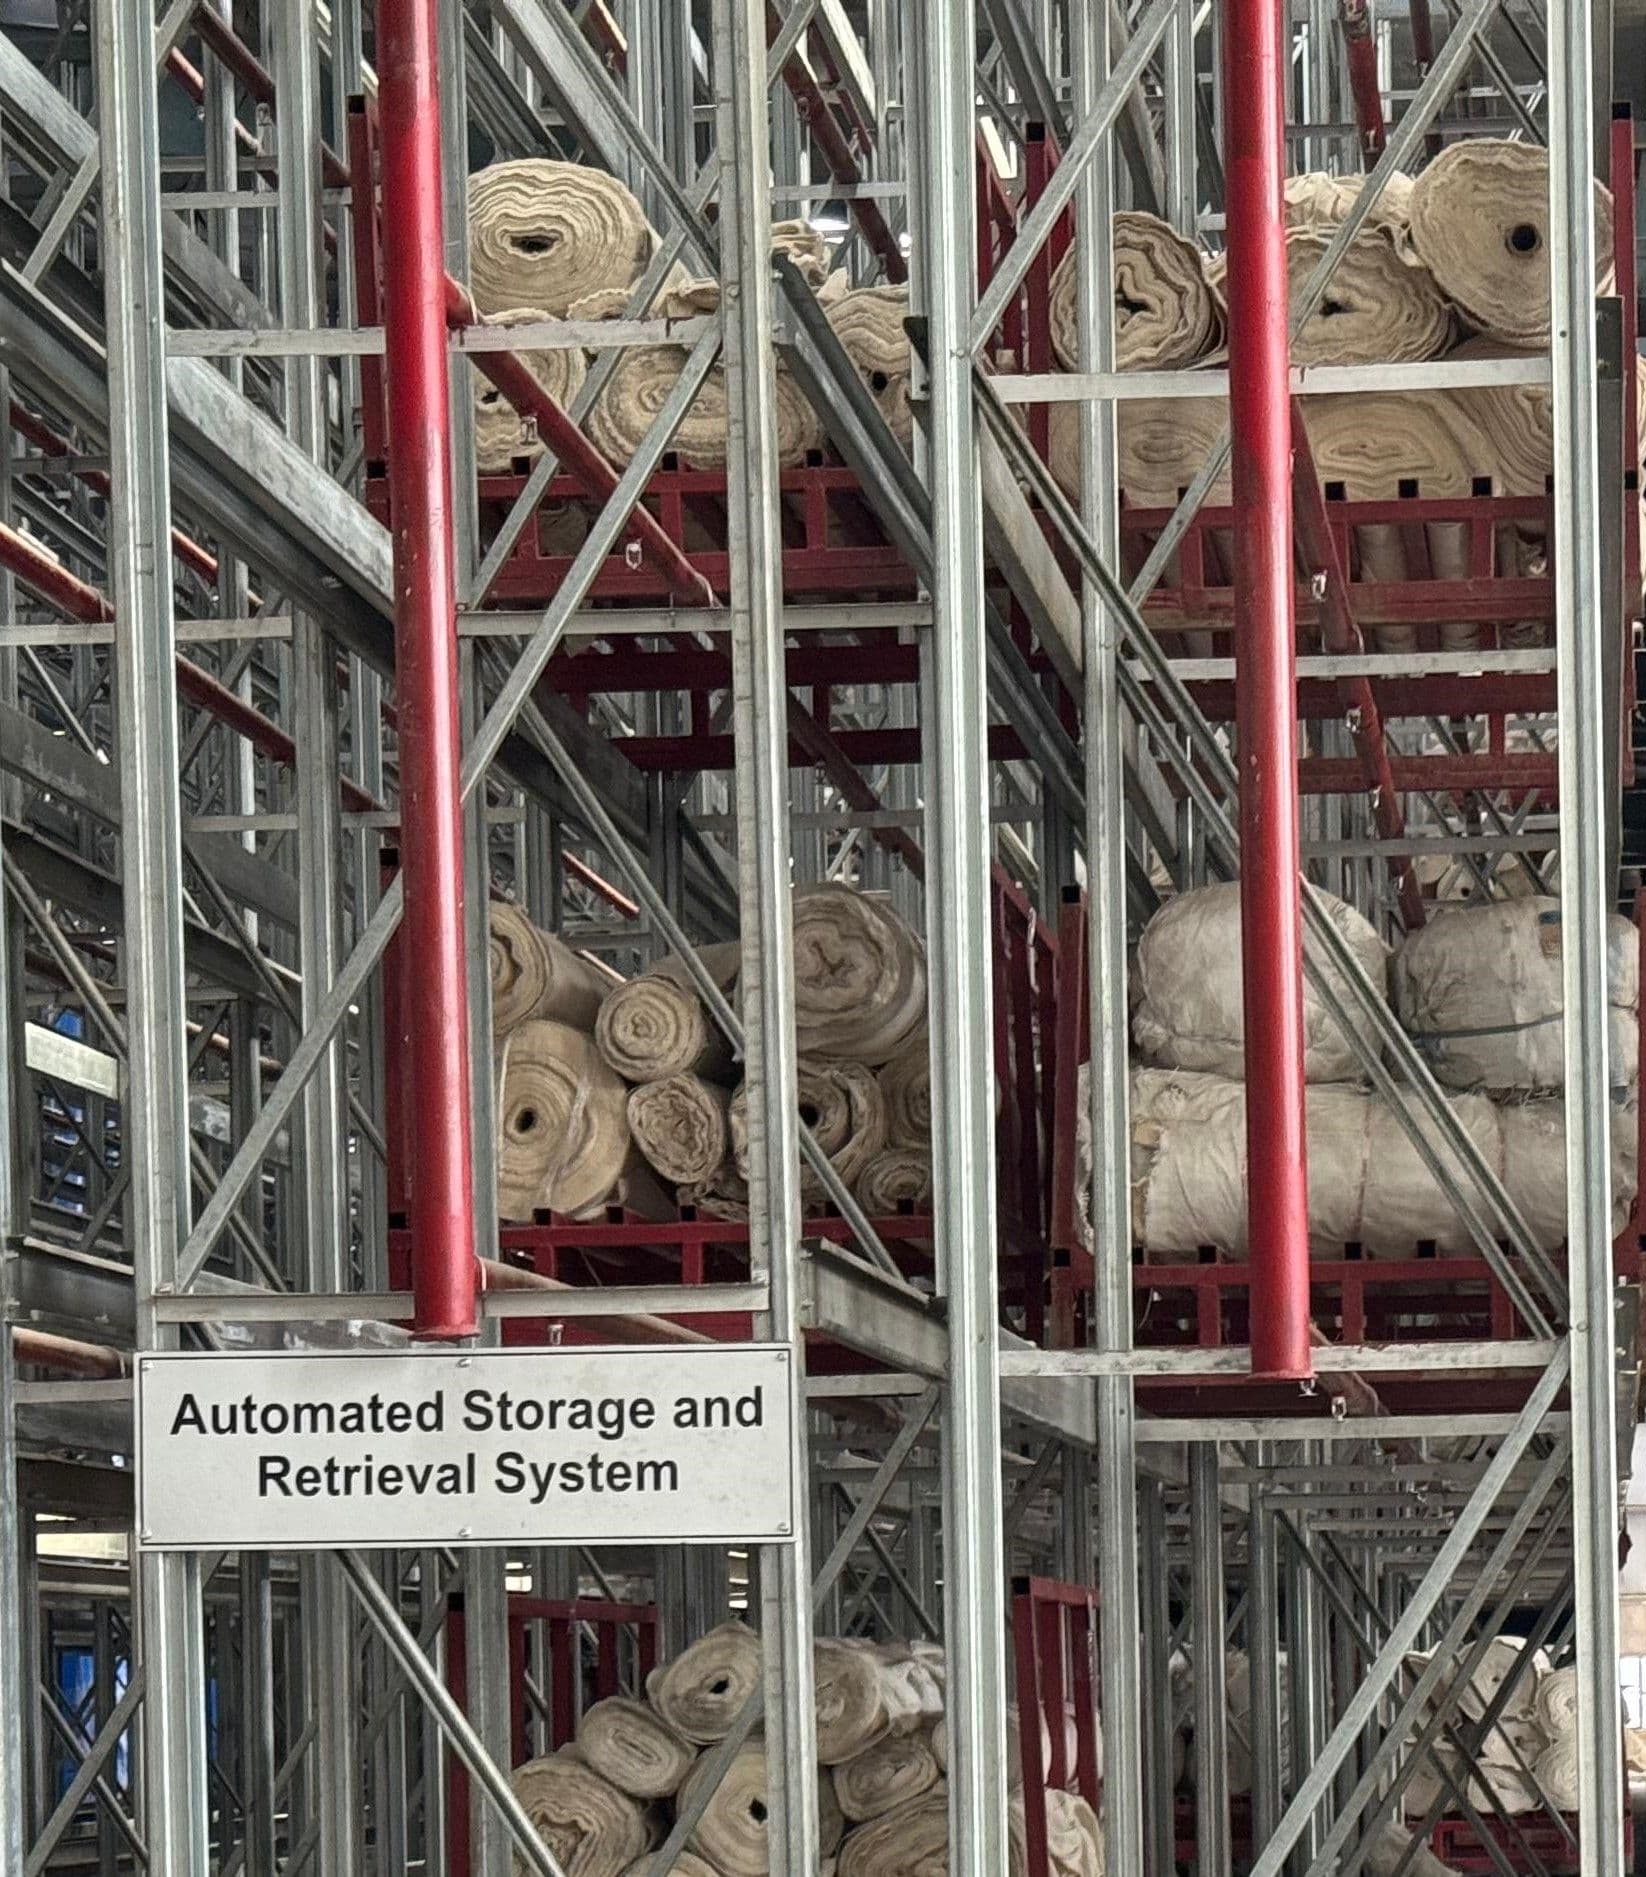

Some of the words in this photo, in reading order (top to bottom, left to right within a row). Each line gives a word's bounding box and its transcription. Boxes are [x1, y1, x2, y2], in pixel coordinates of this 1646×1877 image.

[170, 1390, 445, 1436] Automated
[463, 1390, 656, 1441] Storage
[673, 1385, 763, 1428] and
[259, 1453, 477, 1497] Retrieval
[495, 1451, 680, 1505] System
